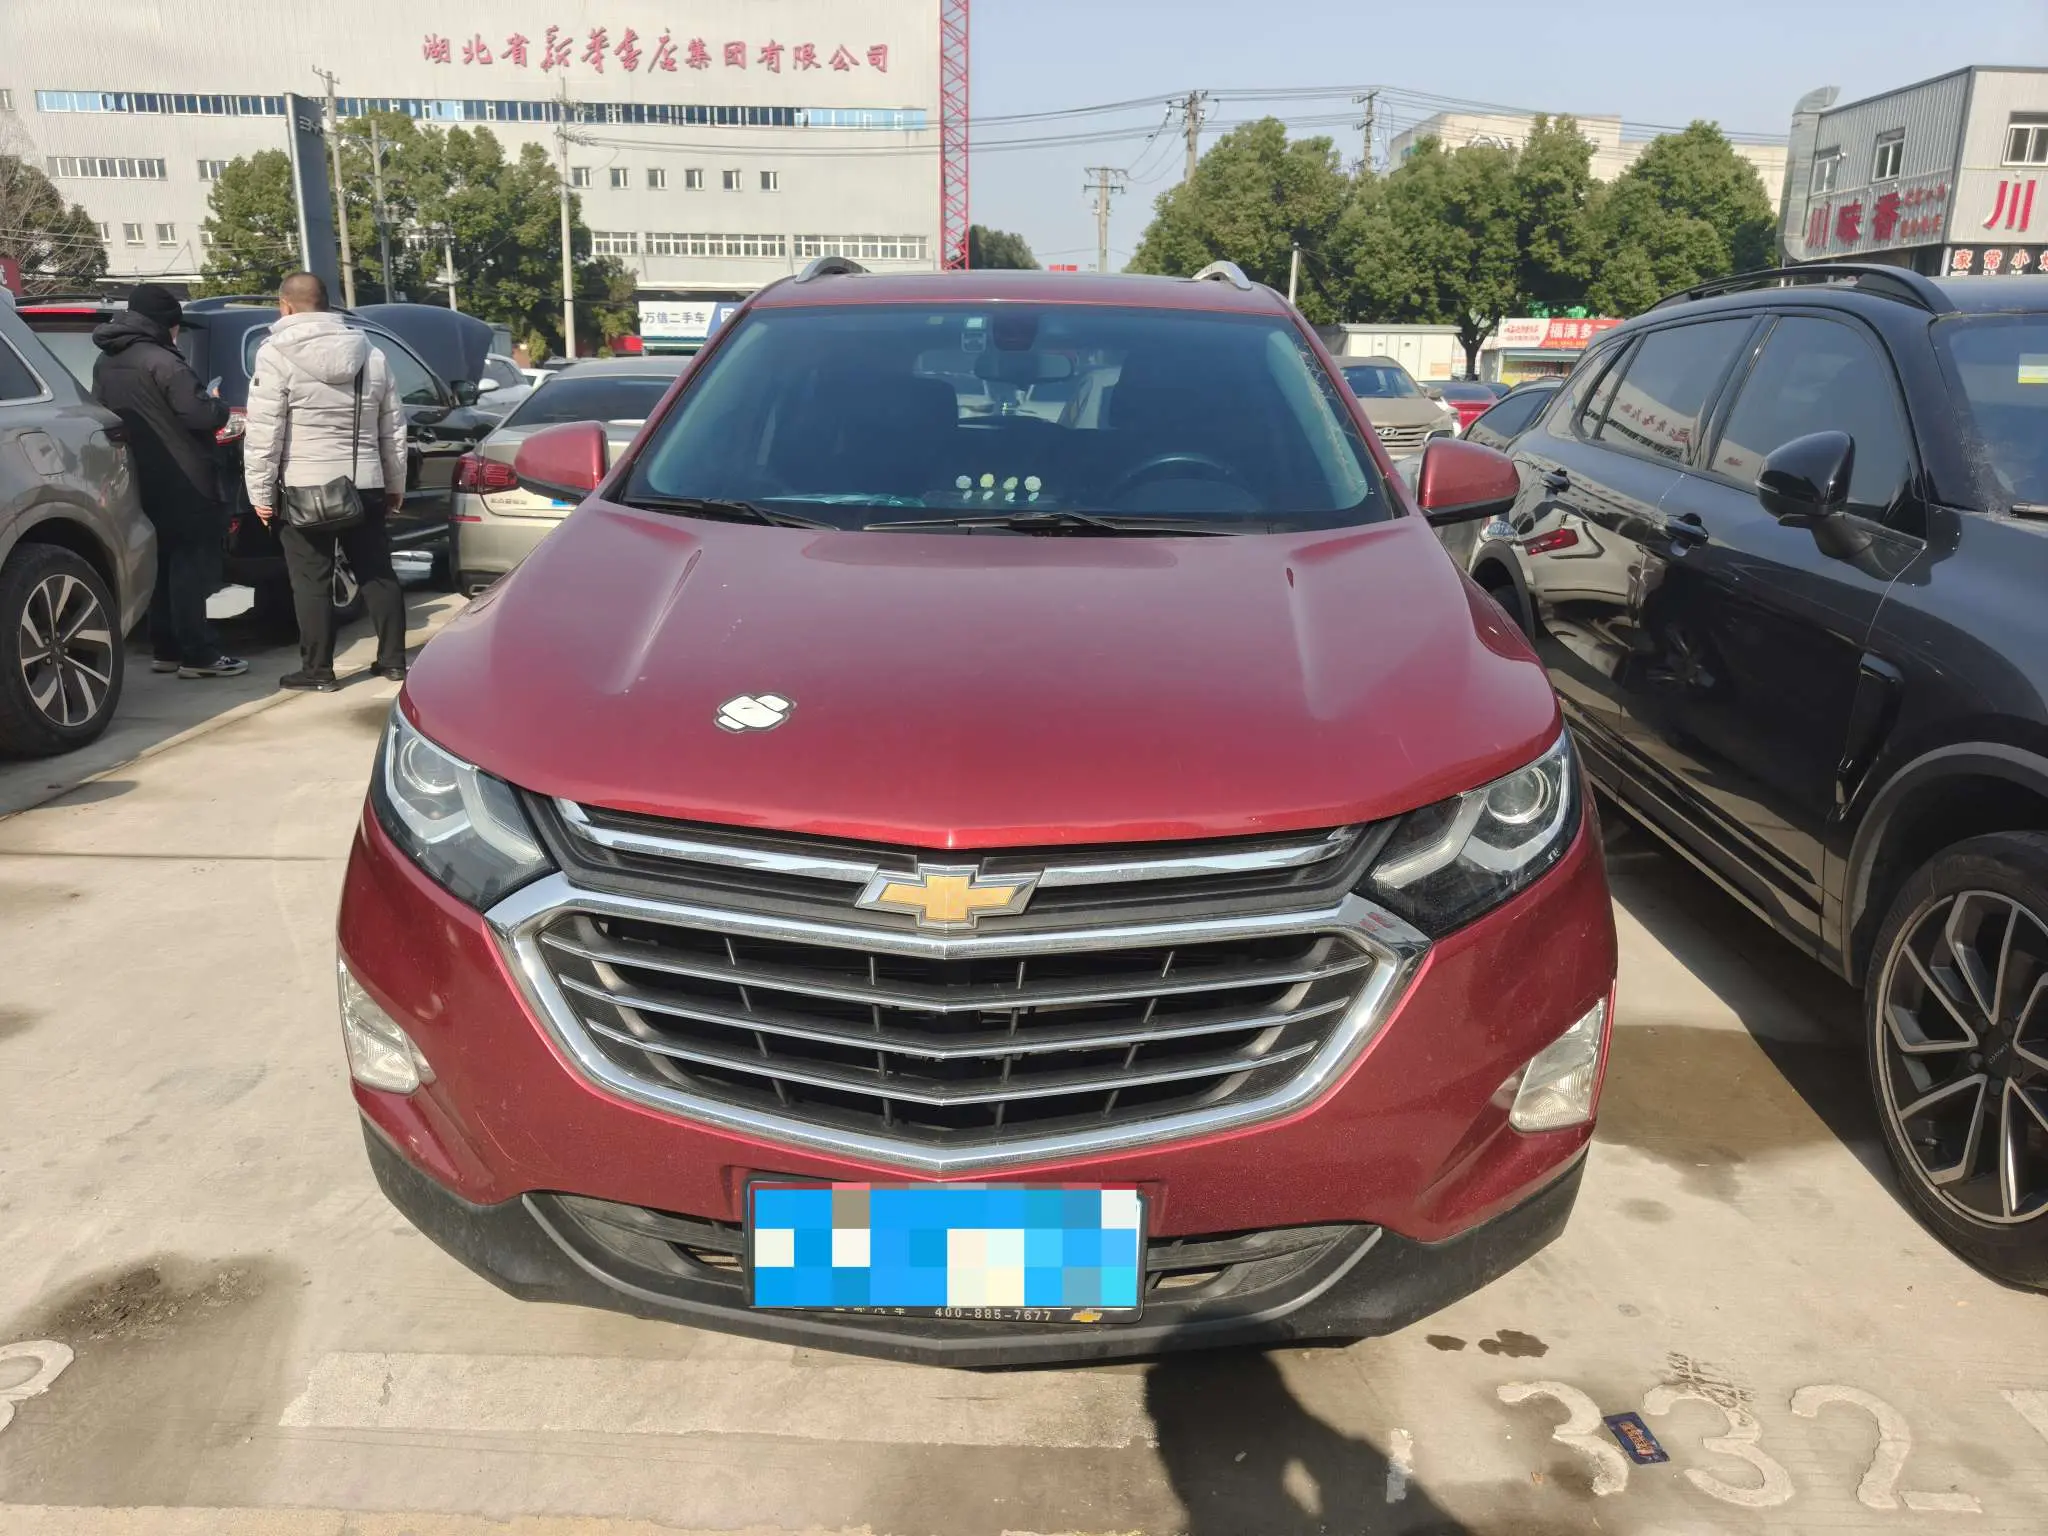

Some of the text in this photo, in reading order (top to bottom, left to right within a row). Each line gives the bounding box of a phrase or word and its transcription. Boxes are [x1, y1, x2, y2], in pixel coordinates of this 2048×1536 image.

[1982, 180, 2037, 232] 川
[644, 311, 706, 324] 万信二手车
[1550, 322, 1609, 341] 福满多
[935, 1307, 1051, 1321] 400-885-7677
[1497, 1380, 1983, 1513] 332
